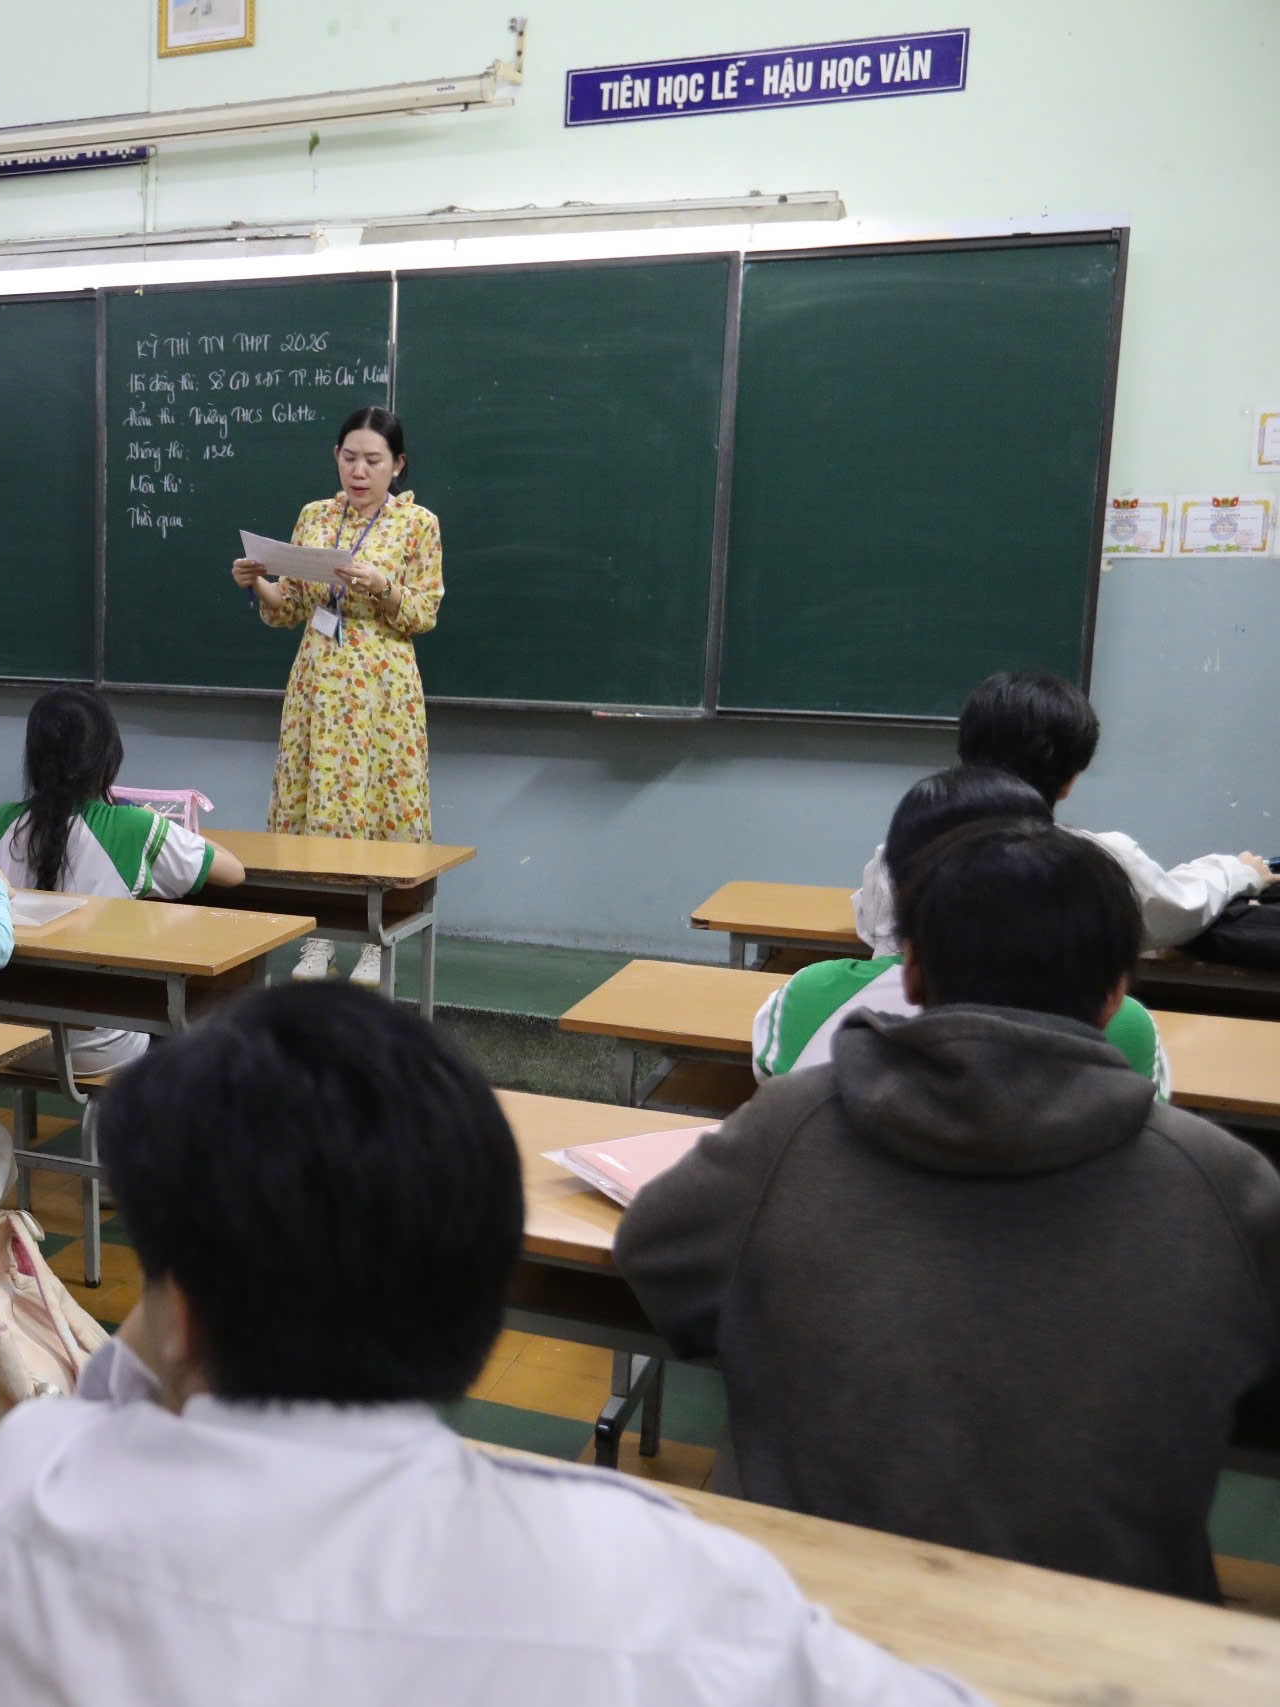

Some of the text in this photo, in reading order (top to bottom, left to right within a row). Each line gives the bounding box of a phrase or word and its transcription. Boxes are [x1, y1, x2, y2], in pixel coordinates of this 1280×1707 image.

[657, 72, 704, 109] HỌC
[711, 60, 747, 101] LỄ
[763, 57, 814, 99] HẬU
[820, 55, 872, 93] HỌC
[880, 44, 932, 84] VĂN
[233, 332, 271, 352] THPT
[280, 331, 330, 352] 2026
[231, 405, 263, 425] THCS
